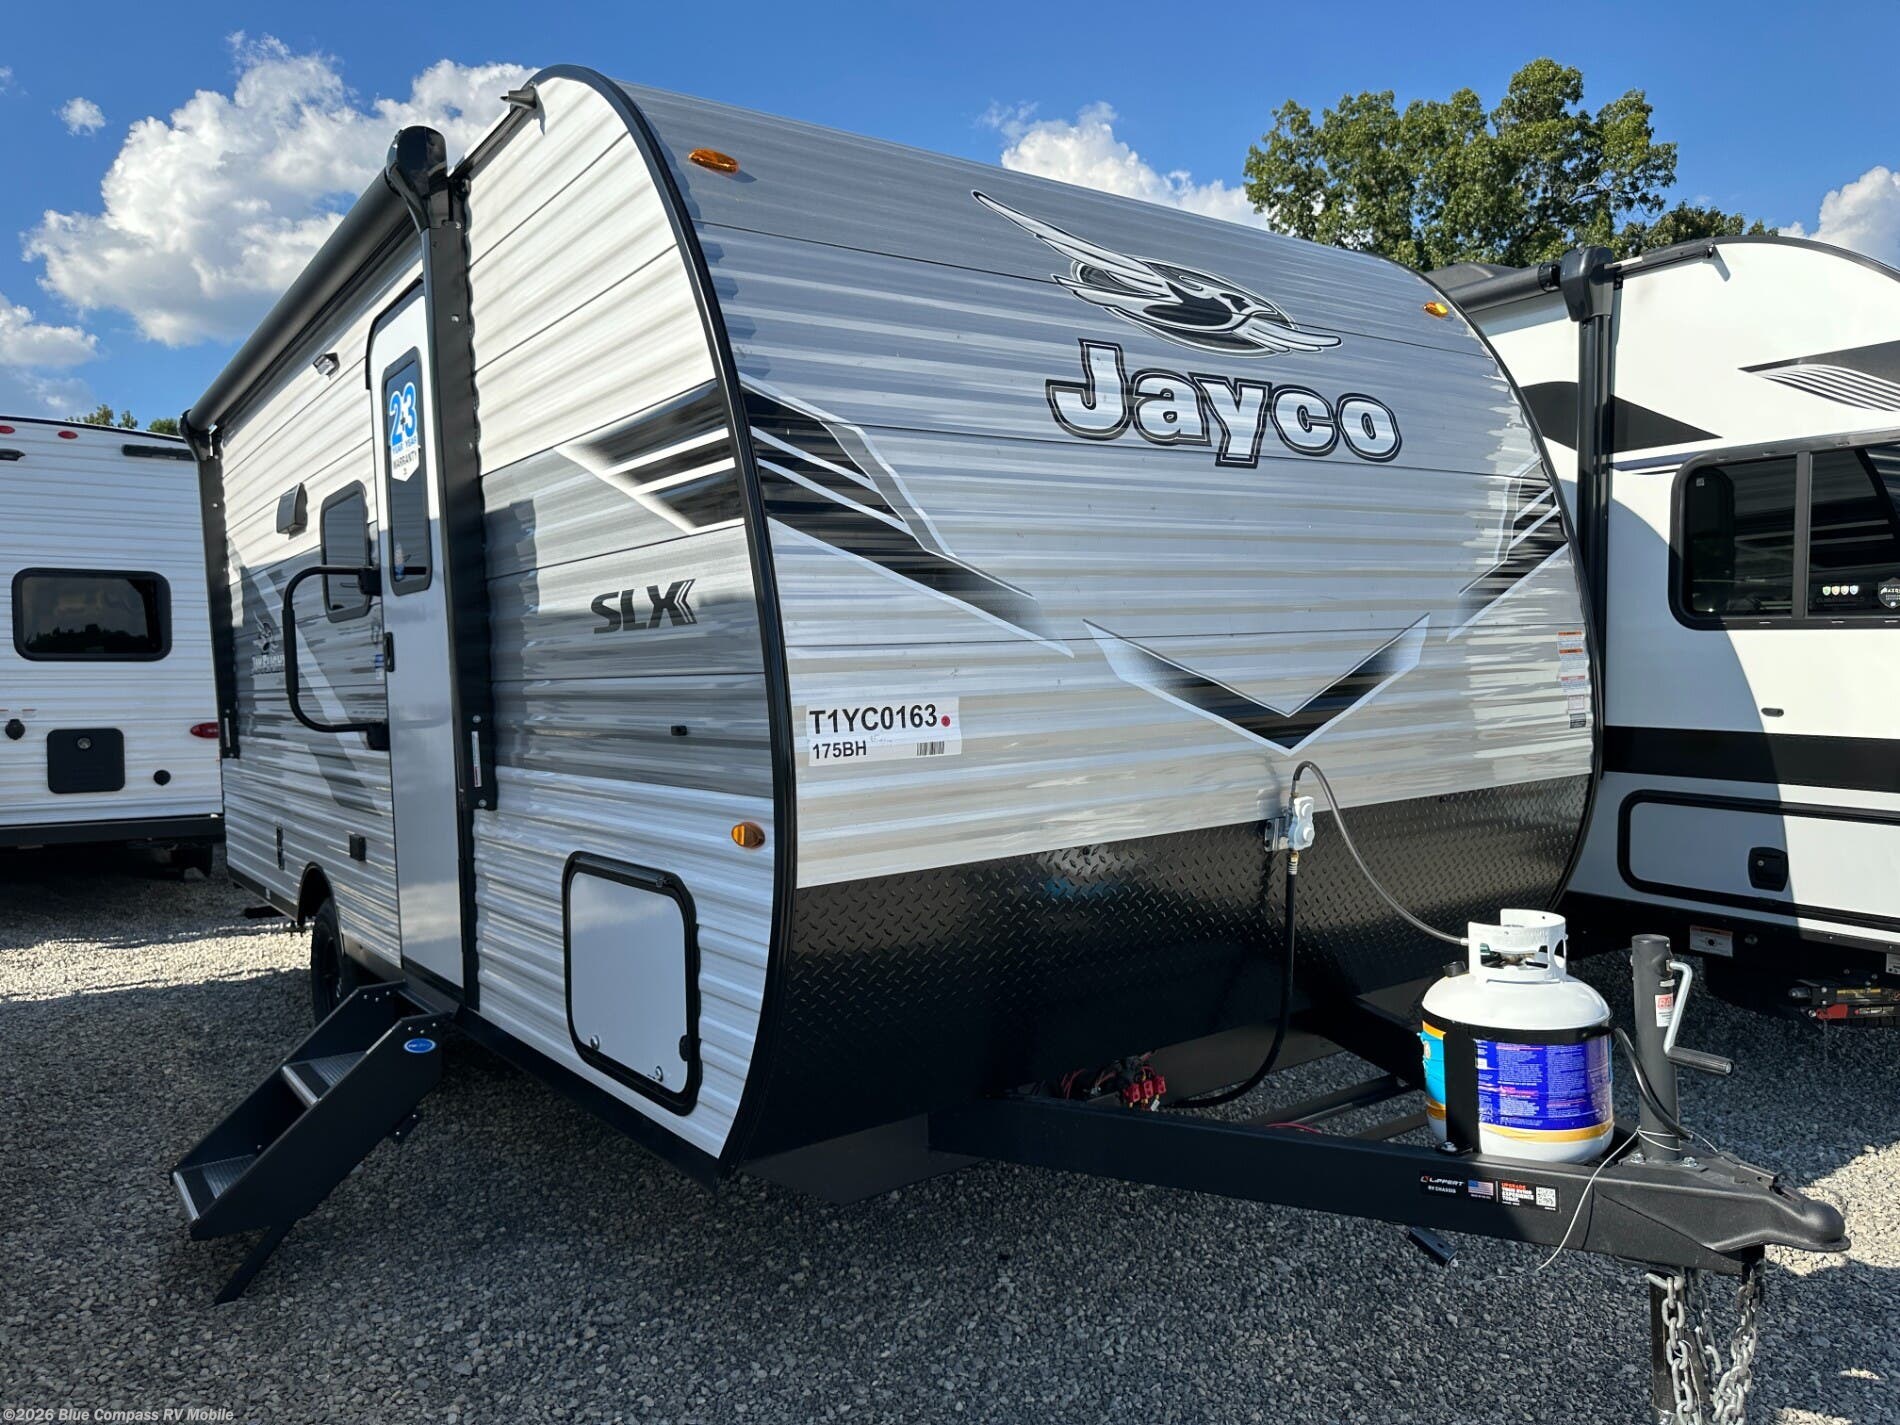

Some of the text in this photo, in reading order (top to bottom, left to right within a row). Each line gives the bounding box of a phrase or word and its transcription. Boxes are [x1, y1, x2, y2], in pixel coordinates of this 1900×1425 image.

[1045, 338, 1402, 468] Jayco
[591, 579, 697, 634] SLX
[809, 704, 937, 734] T1YC0163
[812, 740, 867, 759] 175BH
[1429, 1178, 1464, 1186] LIPPERT
